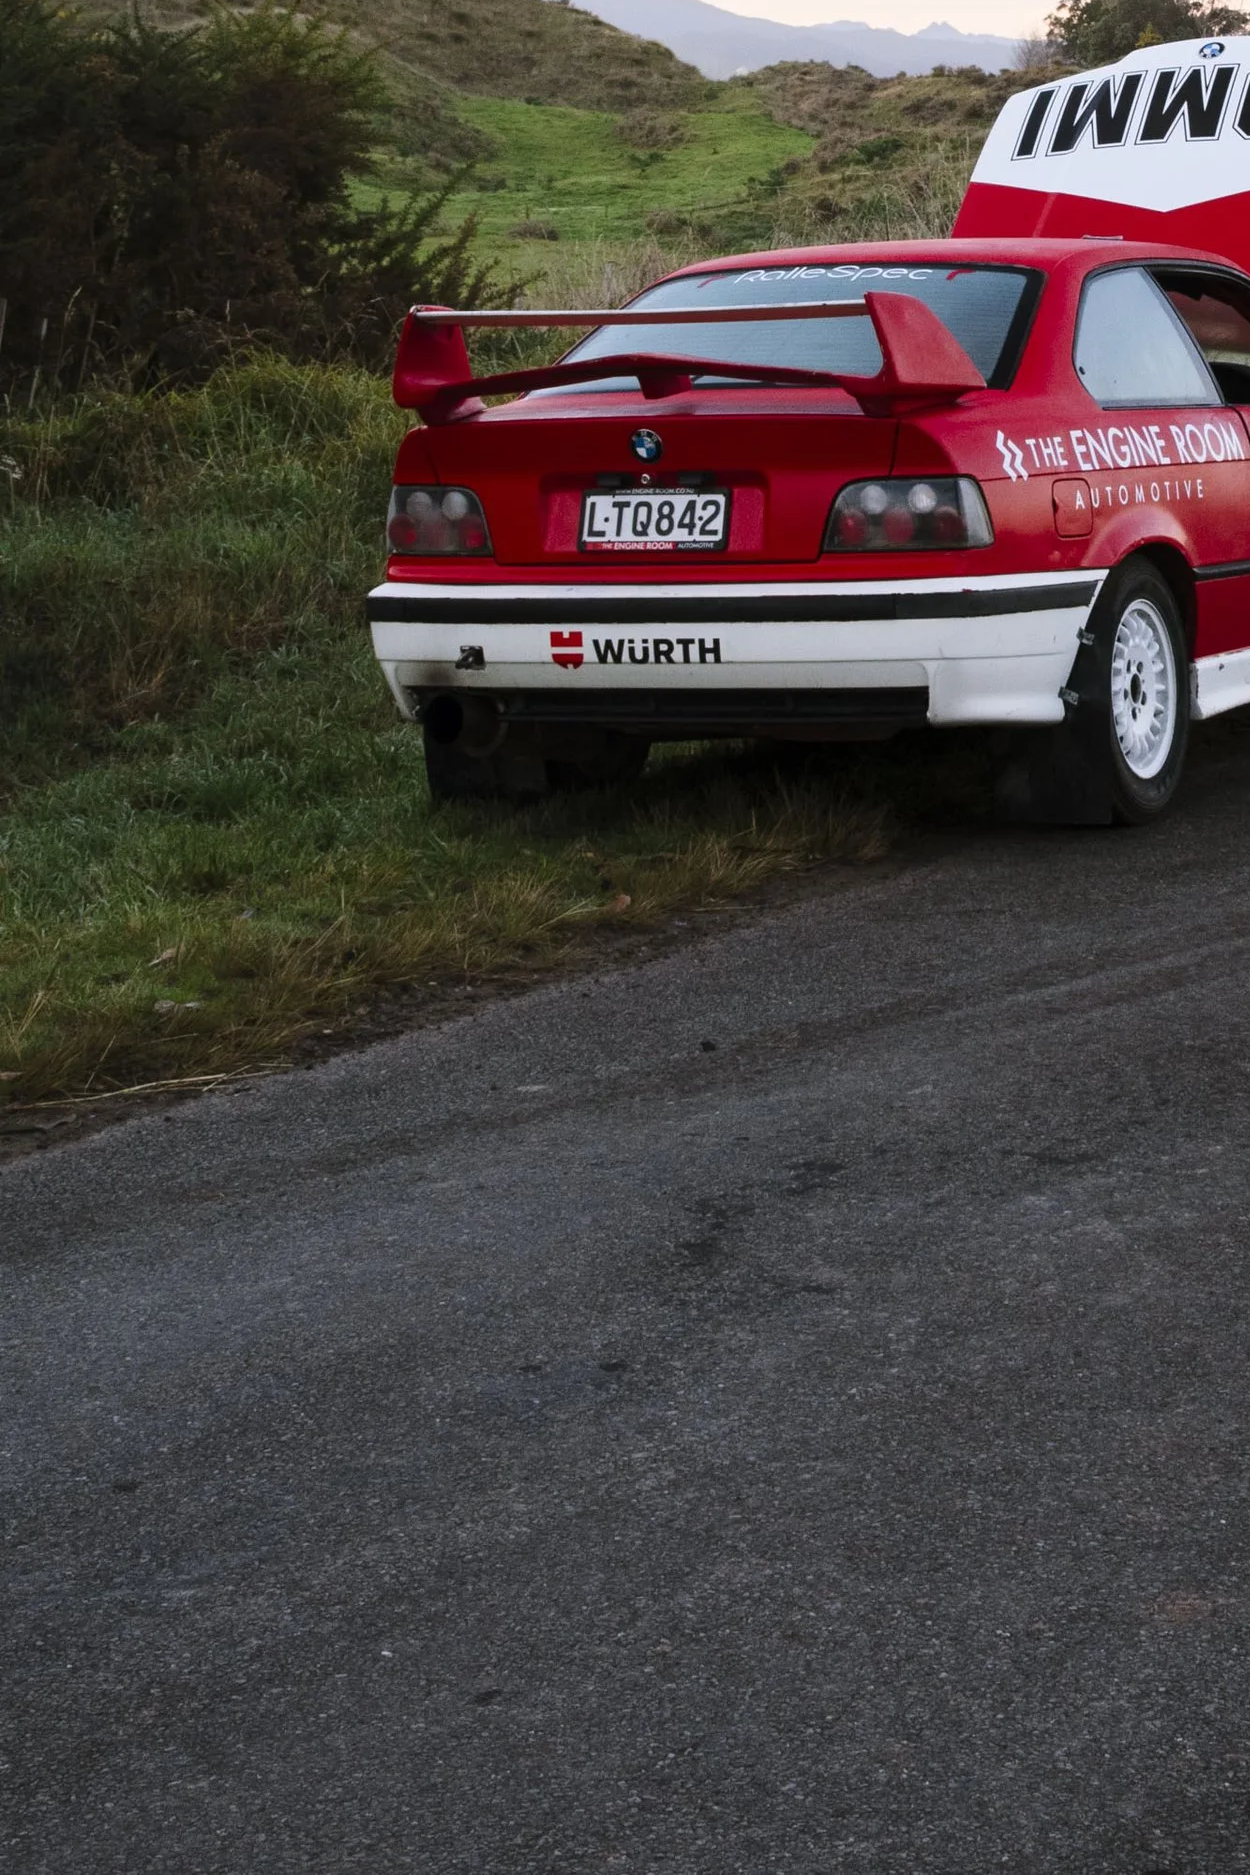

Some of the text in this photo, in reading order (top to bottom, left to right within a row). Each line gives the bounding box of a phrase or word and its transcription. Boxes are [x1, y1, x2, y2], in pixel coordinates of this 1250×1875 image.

[1025, 422, 1245, 471] THE ENGINE ROOM
[1075, 479, 1204, 510] AUTOMOTIVE
[587, 500, 721, 537] LTQ842
[614, 542, 644, 550] ENGINE
[646, 541, 673, 550] ROOM
